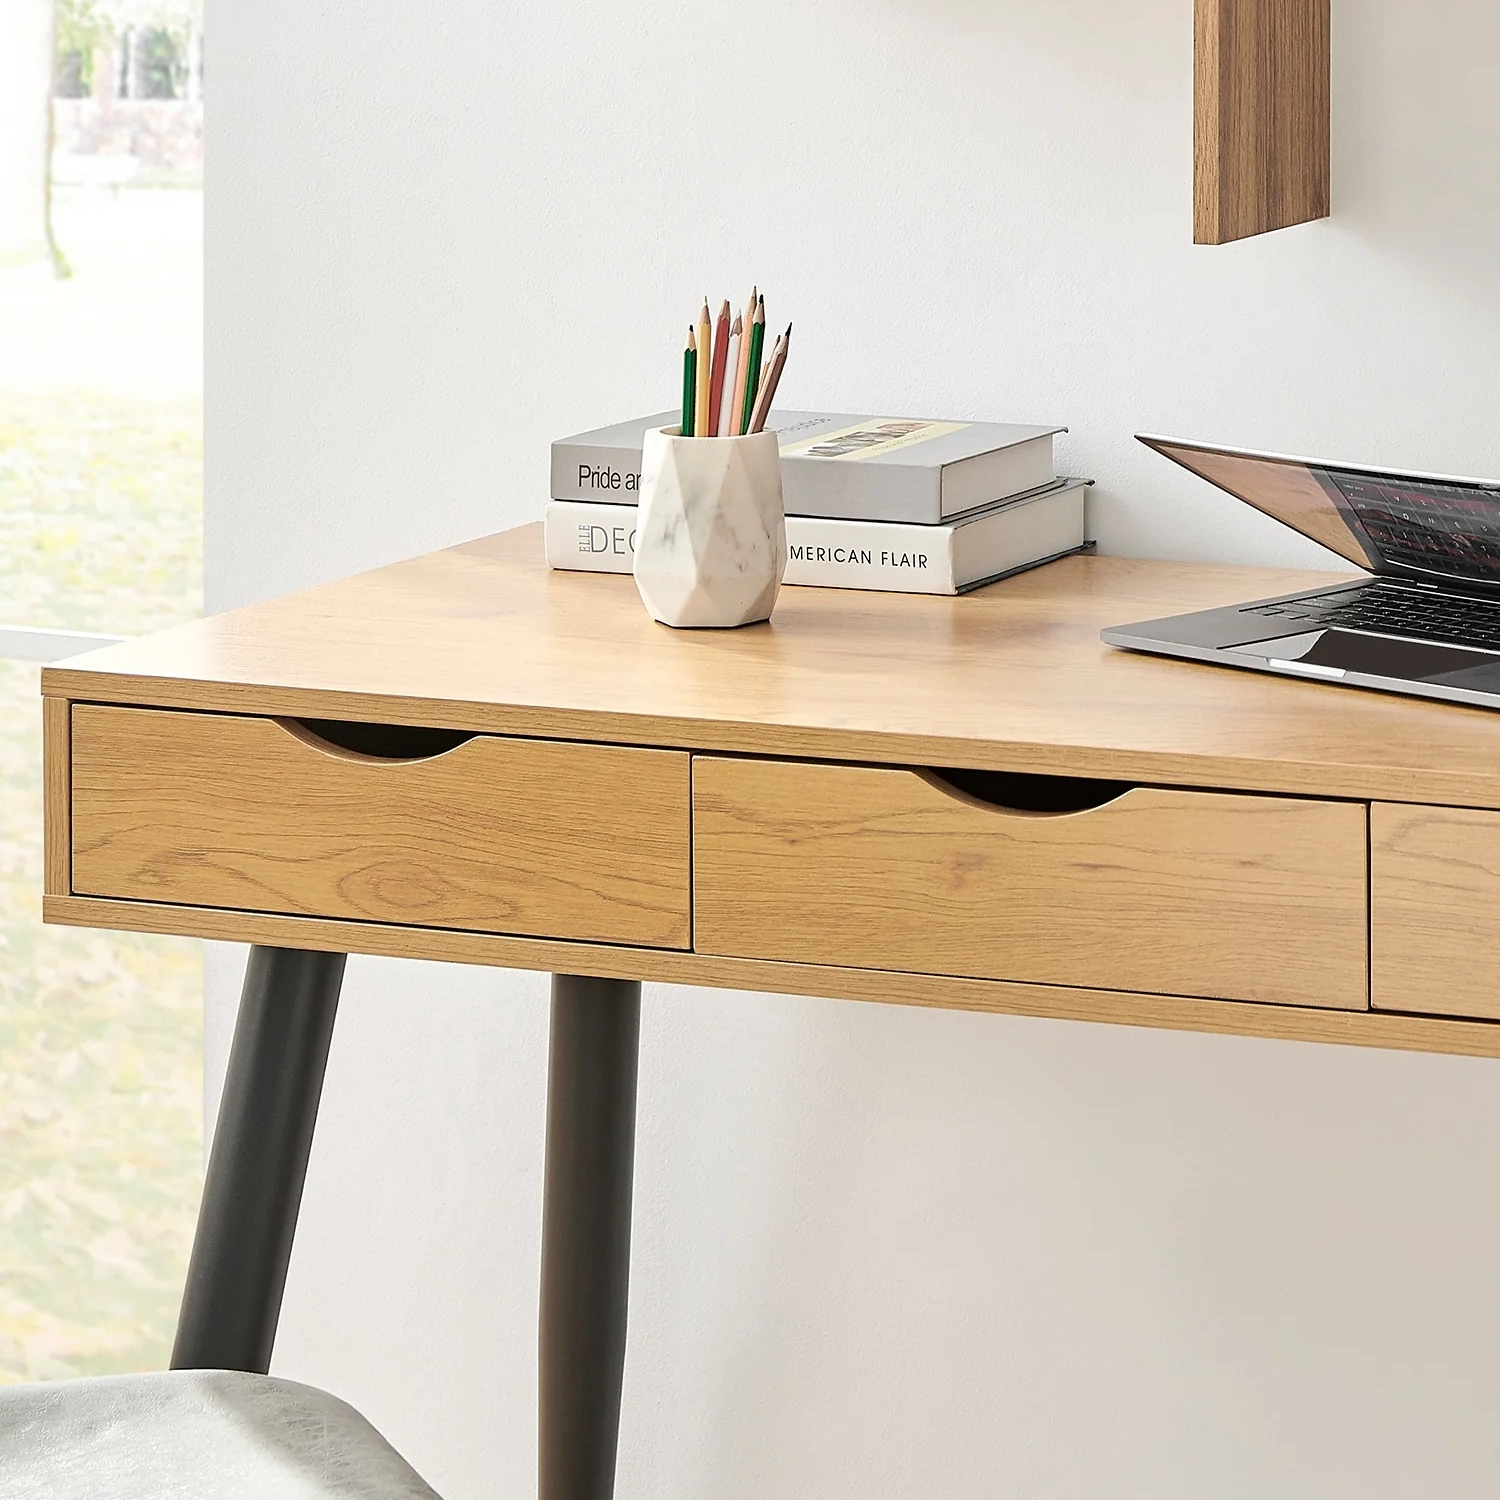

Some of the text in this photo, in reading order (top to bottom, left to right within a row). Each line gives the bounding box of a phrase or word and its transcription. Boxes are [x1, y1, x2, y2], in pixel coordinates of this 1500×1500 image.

[578, 464, 622, 490] Pride
[578, 524, 591, 553] ELLE
[881, 551, 928, 569] FLAIR
